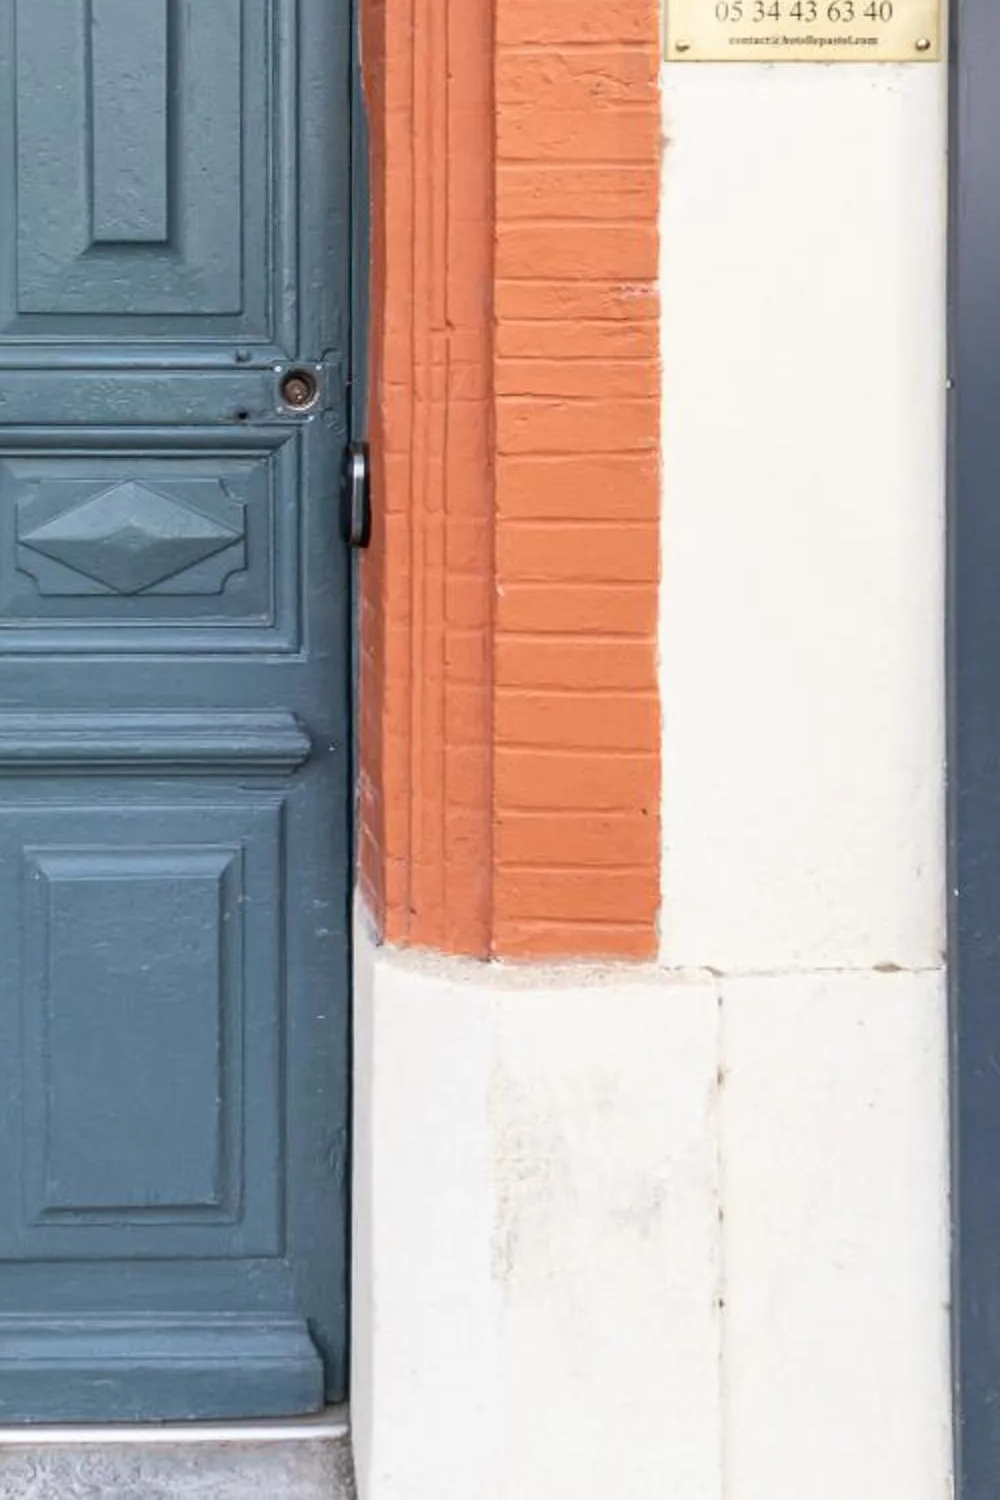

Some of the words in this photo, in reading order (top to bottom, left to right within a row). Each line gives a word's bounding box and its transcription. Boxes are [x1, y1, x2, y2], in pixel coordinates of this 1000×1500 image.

[715, 0, 743, 22] 05
[752, 0, 781, 22] 34
[789, 0, 817, 22] 43
[827, 0, 855, 22] 63
[863, 0, 893, 22] 40
